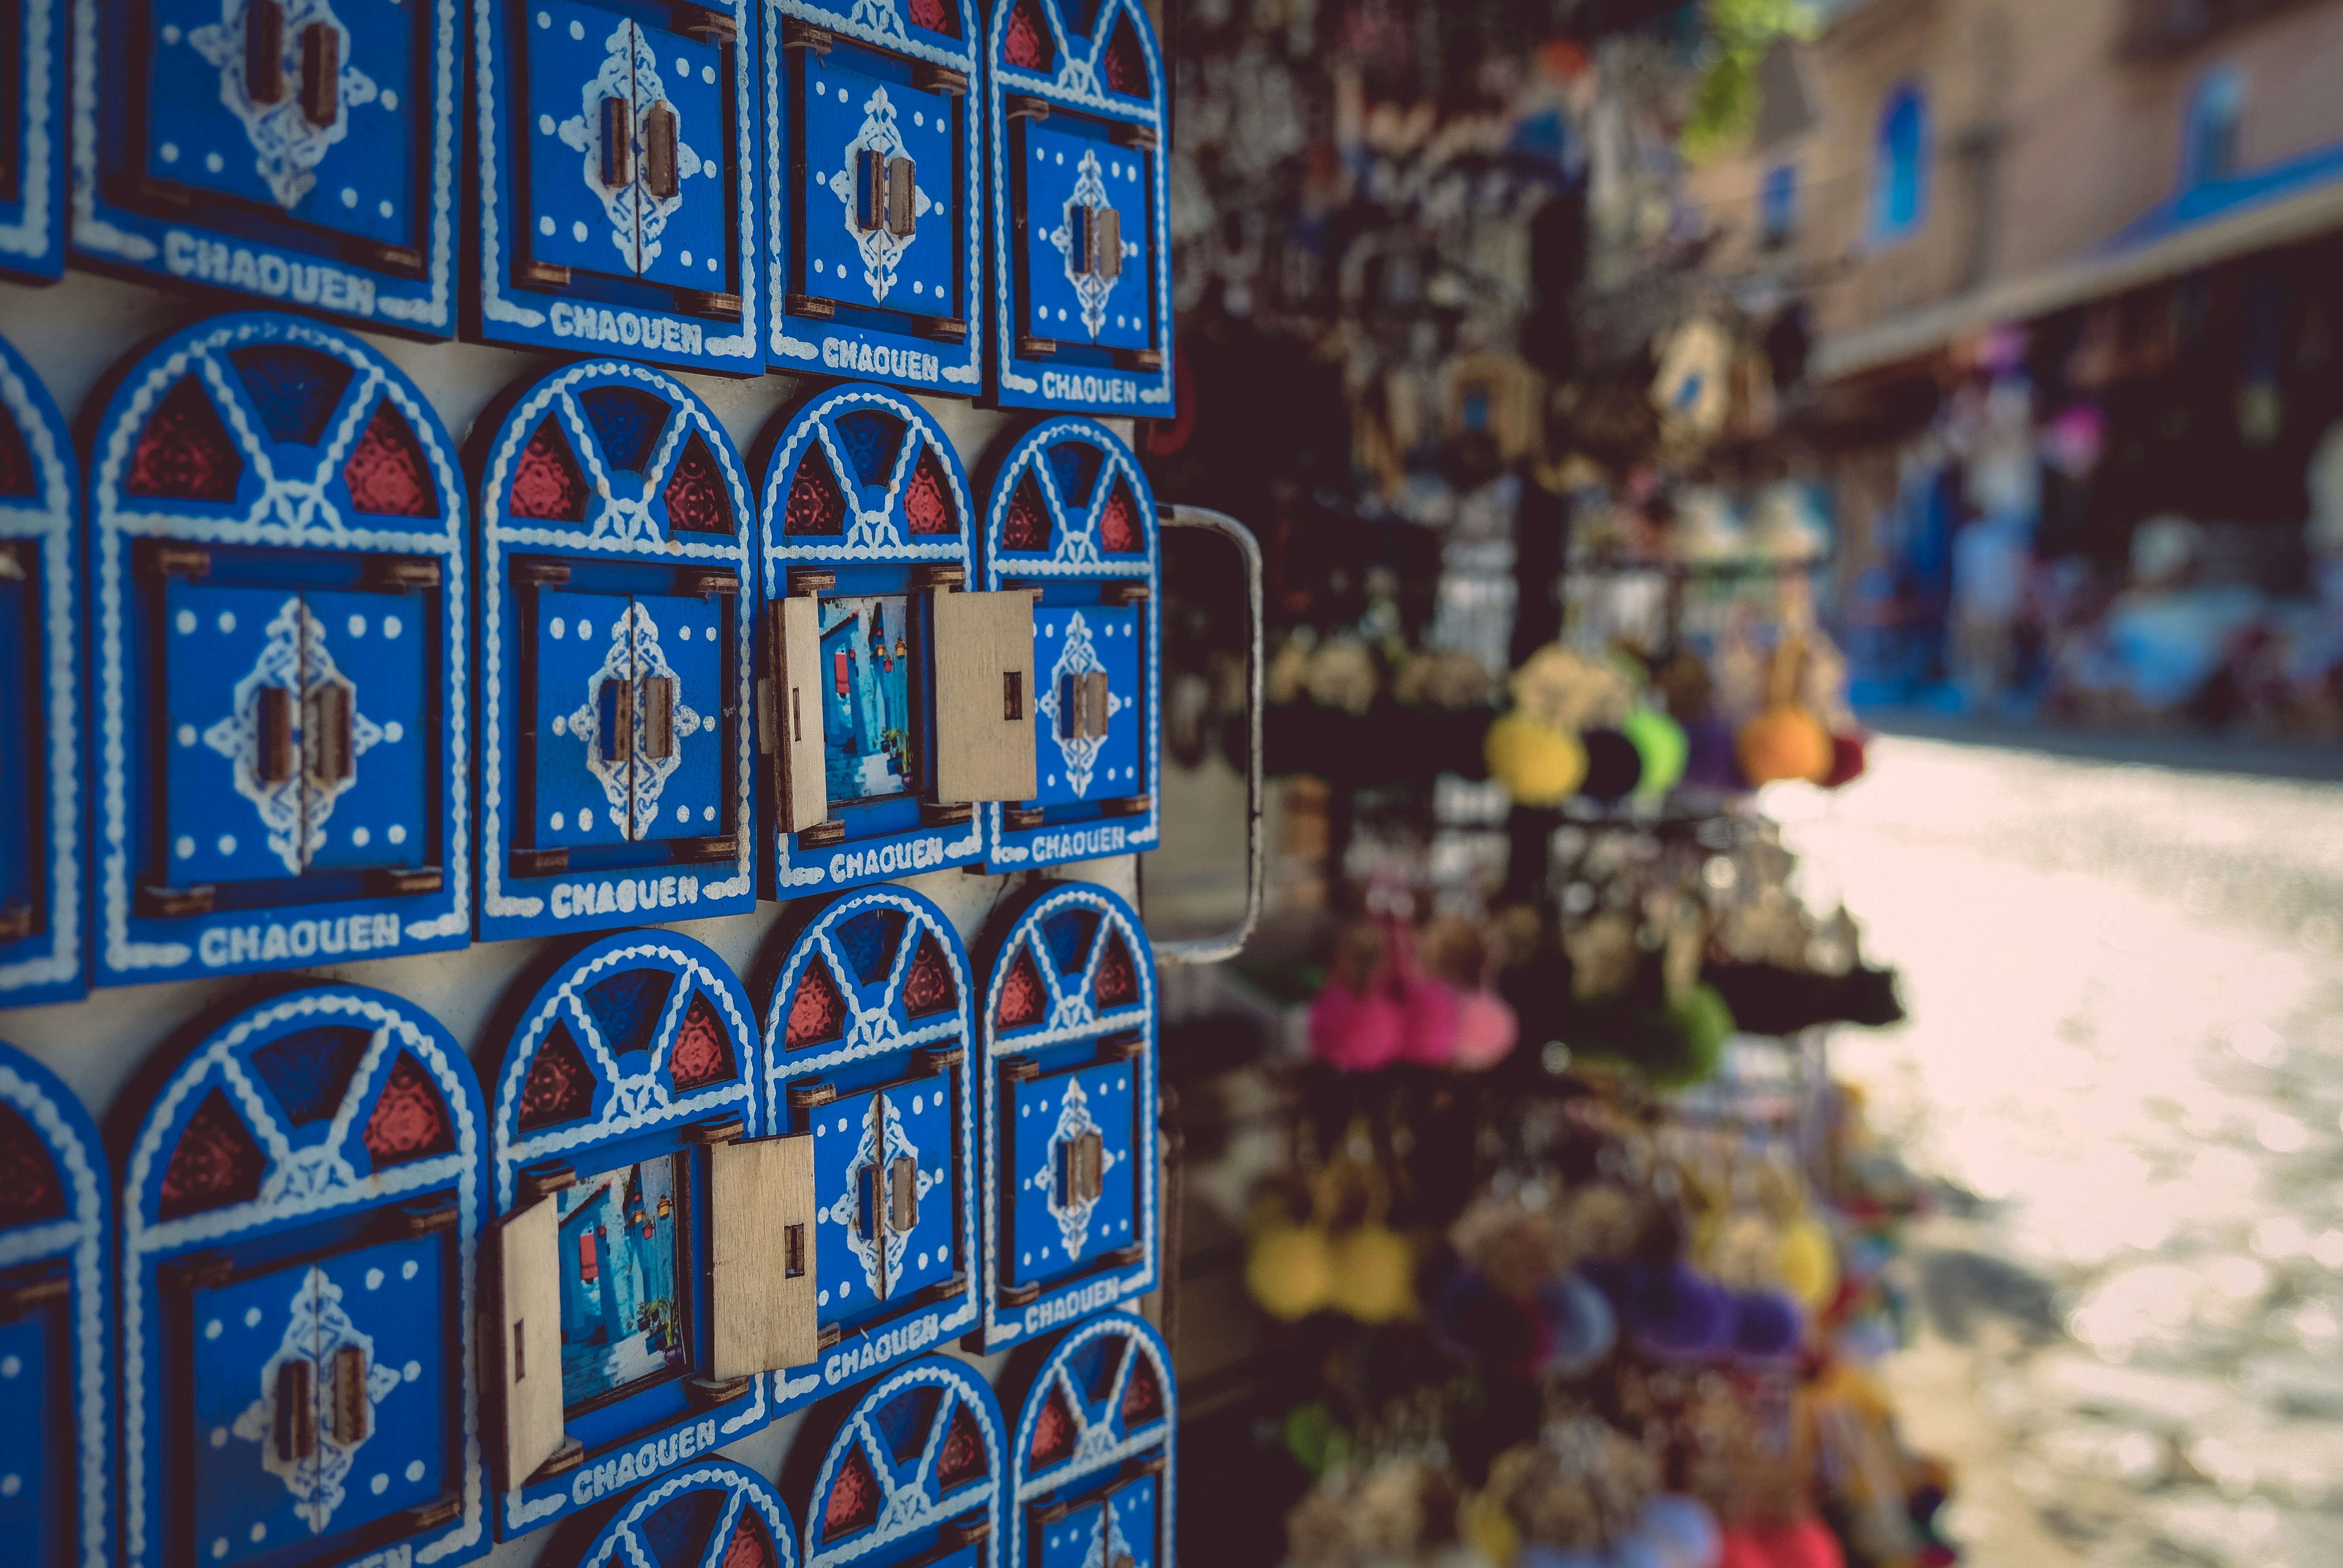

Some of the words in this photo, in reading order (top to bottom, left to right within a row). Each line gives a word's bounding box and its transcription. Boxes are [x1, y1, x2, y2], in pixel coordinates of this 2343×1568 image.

[165, 230, 376, 317] CHAOUEN
[550, 302, 702, 355] CHAOUEN
[823, 337, 938, 382] CHAOUEN
[1042, 371, 1136, 404] CHAOUEN
[829, 837, 943, 883] CHAOUEN
[1032, 826, 1124, 863] CHAOUEN
[551, 876, 698, 919] CHAOUEN
[200, 913, 399, 968] CHAOUEN
[1025, 1276, 1119, 1334] CHAOUEN
[824, 1313, 939, 1385] CHAOUEN
[572, 1419, 715, 1505] CHAOUEN
